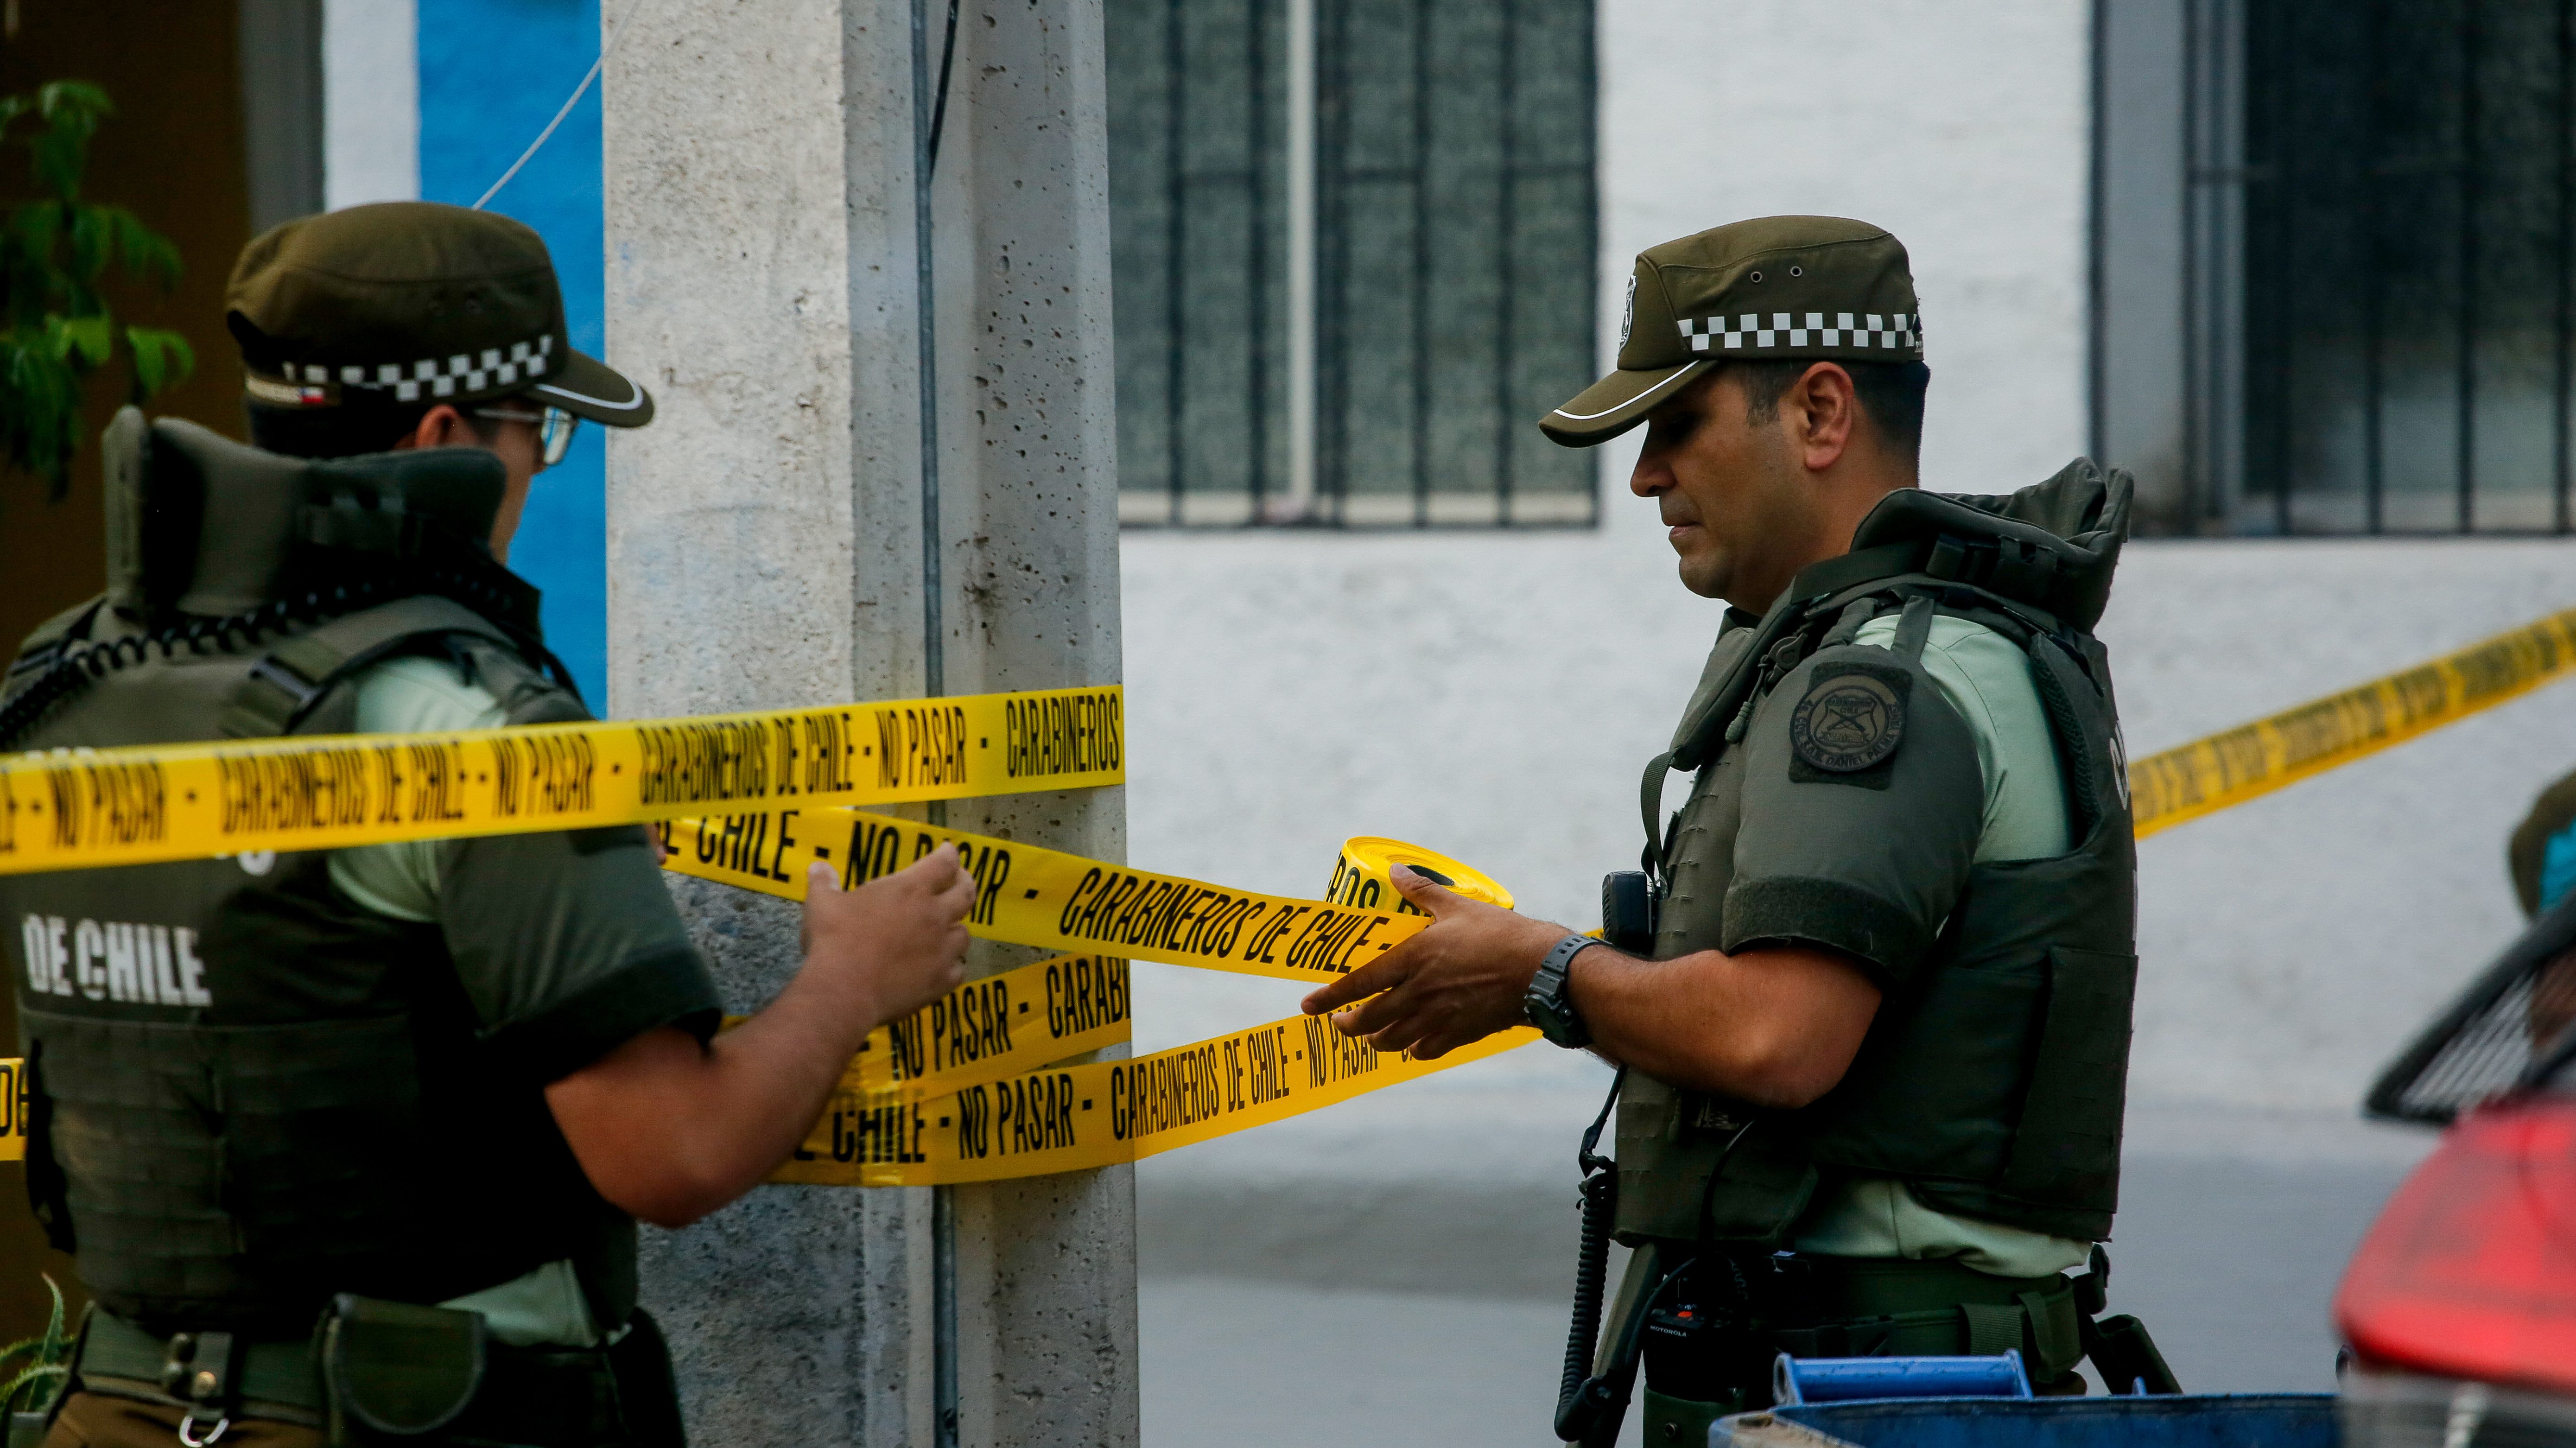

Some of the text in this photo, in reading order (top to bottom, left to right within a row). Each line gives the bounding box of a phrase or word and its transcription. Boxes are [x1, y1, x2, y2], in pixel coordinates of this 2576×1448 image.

[374, 745, 401, 824] DE
[406, 739, 466, 823] CHILE
[488, 736, 518, 818] NO
[523, 732, 597, 812] PASAR
[637, 719, 769, 805] CARABINEROS
[775, 716, 799, 796] DE
[804, 711, 854, 793] CHILE
[875, 708, 902, 789] NO
[906, 705, 968, 787] PASAR
[1005, 692, 1121, 779] CARABINEROS
[698, 809, 800, 883] CHILE
[843, 820, 900, 892] NO
[1060, 867, 1267, 959] CARABINEROS
[1242, 905, 1312, 964] DE
[1285, 909, 1390, 974] CHILE
[21, 912, 213, 1007] DE CHILE
[933, 979, 1012, 1073] PASAR
[833, 1101, 926, 1162] CHILE
[957, 1085, 988, 1160] NO
[996, 1073, 1075, 1156] PASAR
[1112, 1043, 1220, 1141] CARABINEROS
[1224, 1038, 1245, 1113] DE
[1247, 1025, 1290, 1105] CHILE
[1303, 1014, 1326, 1090] NO
[1650, 1325, 1687, 1337] MOTOROLA
